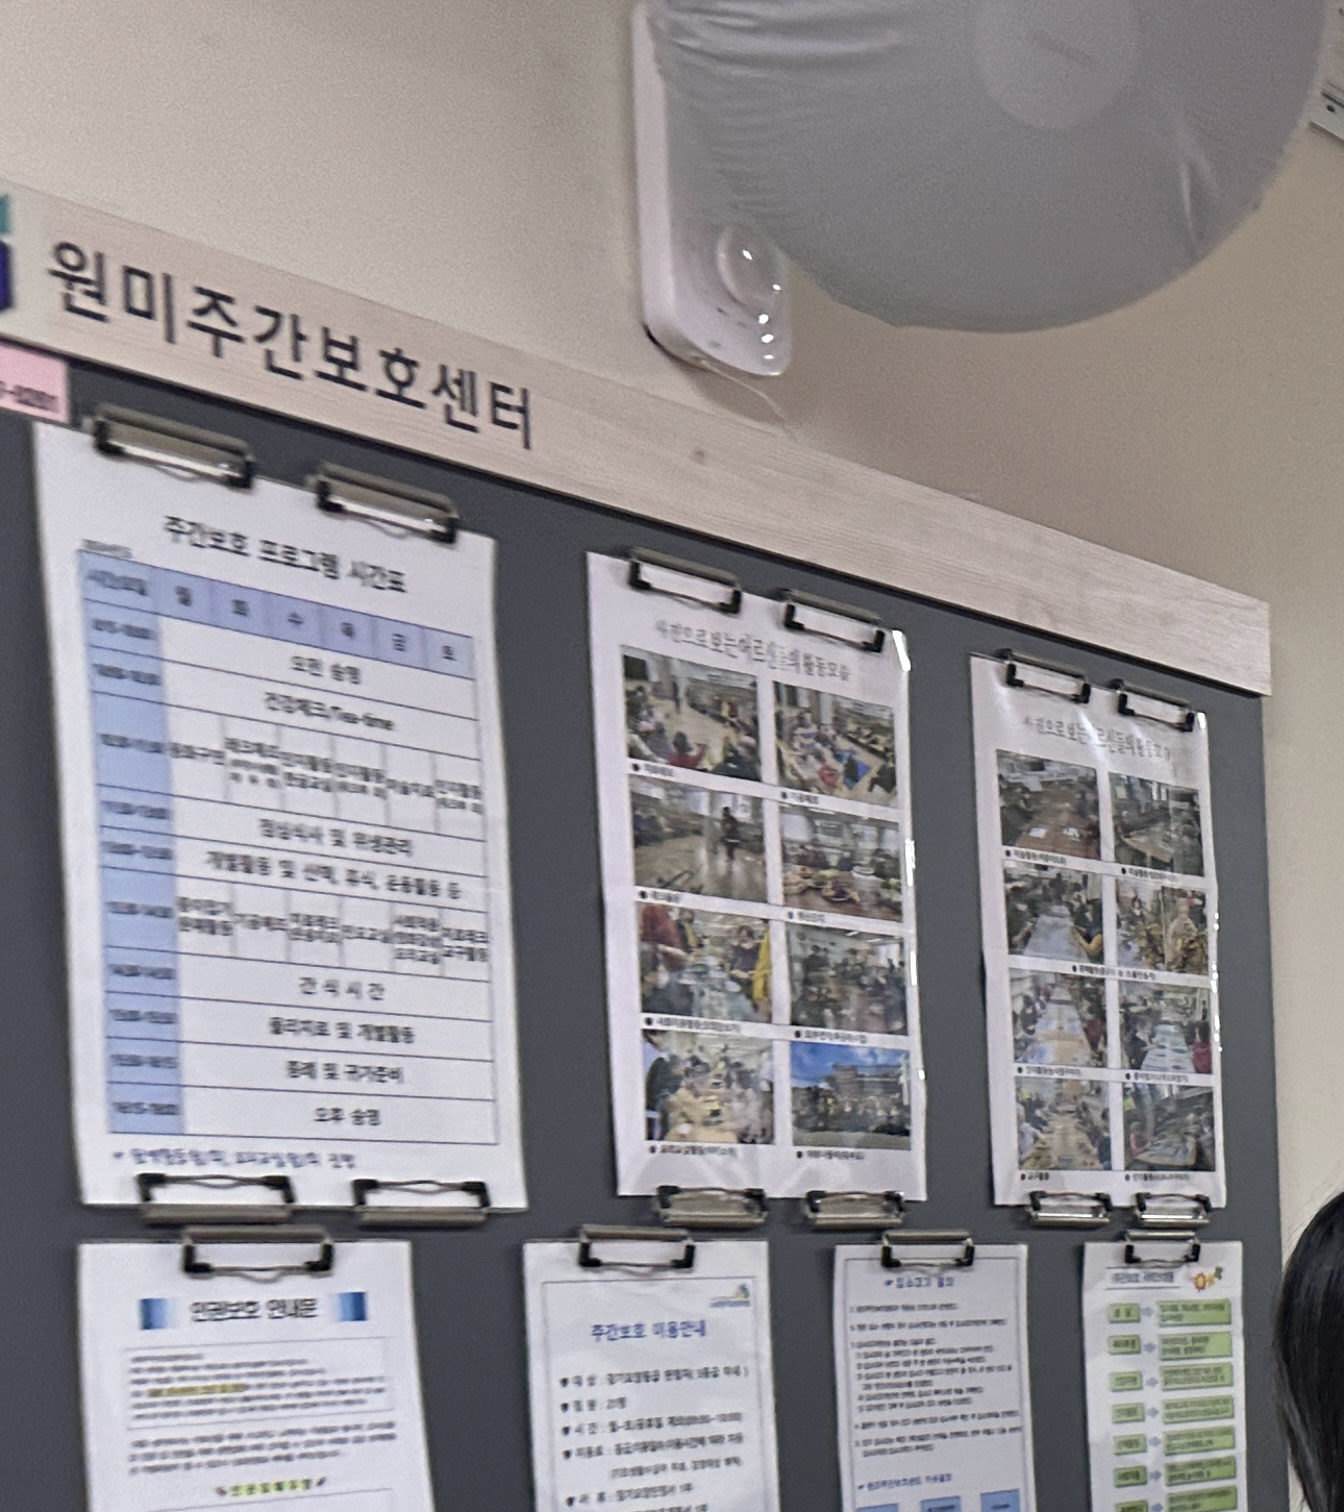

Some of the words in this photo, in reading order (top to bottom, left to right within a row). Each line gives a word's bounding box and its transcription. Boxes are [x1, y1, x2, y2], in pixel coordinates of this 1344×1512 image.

[48, 239, 532, 451] 원미주간보호센터
[165, 515, 250, 556] 주간보호
[259, 539, 339, 580] 프로그램
[348, 560, 407, 593] 시간표
[290, 655, 323, 679] 오전
[591, 1323, 646, 1342] 주간보호
